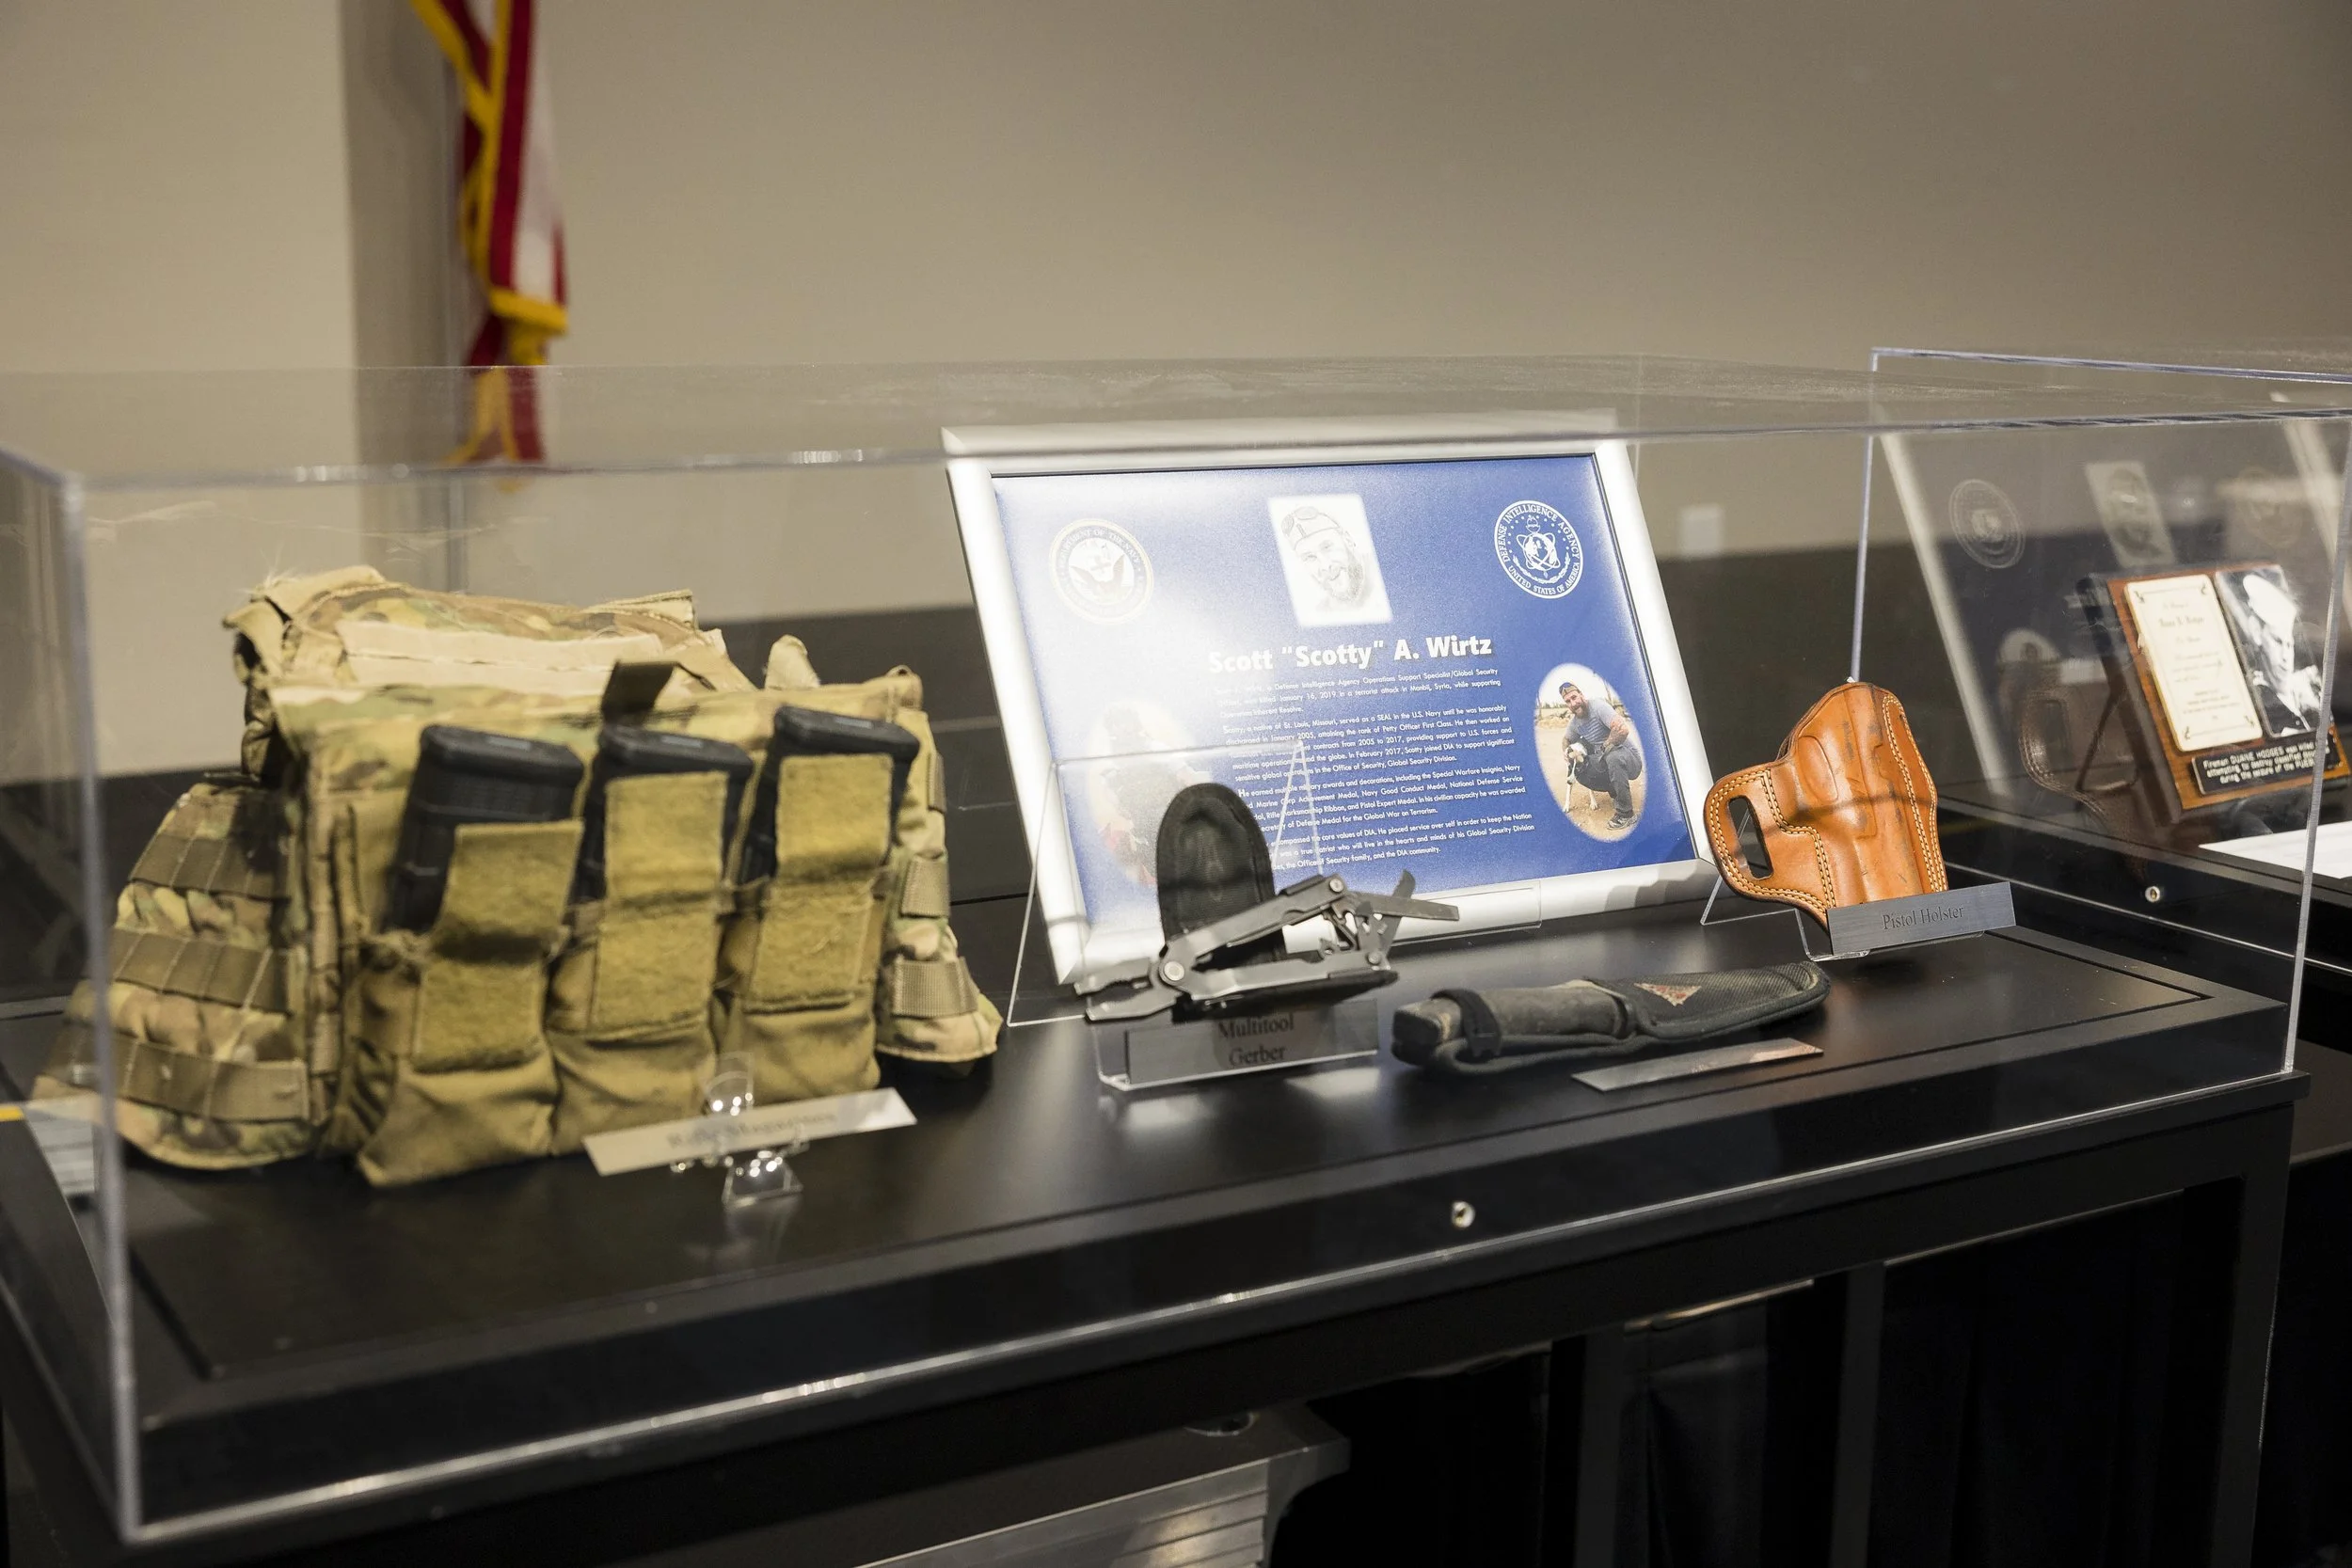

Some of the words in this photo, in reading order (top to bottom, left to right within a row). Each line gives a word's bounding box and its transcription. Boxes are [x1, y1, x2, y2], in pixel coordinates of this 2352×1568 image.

[1502, 504, 1559, 524] INTELLIGENCE
[1498, 524, 1511, 562] DEFENSE
[1557, 521, 1581, 559] AGENCY
[1508, 565, 1532, 589] UNITED
[1534, 585, 1556, 595] STATES
[1556, 584, 1565, 593] OF
[1565, 562, 1581, 589] AMERICA
[1208, 648, 1274, 673] Scott
[1281, 640, 1384, 669] "Scotty"
[1393, 639, 1420, 660] A.
[1425, 635, 1492, 658] Wirtz
[1355, 688, 1378, 696] terrorist
[1434, 683, 1452, 691] Syria,
[1471, 679, 1502, 689] supporting
[1362, 676, 1395, 686] Operations
[1398, 673, 1421, 683] Support
[1422, 670, 1473, 681] Specialist/Global
[1475, 668, 1498, 676] Security
[1340, 716, 1359, 724] served
[1313, 741, 1339, 750] contracts
[1406, 734, 1434, 743] providing
[1436, 731, 1457, 739] support
[1232, 761, 1260, 769] maritime
[1327, 753, 1347, 762] globe.
[1405, 746, 1422, 754] Scotty
[1423, 744, 1442, 753] joined
[1464, 740, 1486, 750] support
[1486, 737, 1515, 748] significant
[1262, 770, 1281, 780] global
[1361, 761, 1386, 769] Security,
[1387, 758, 1408, 767] Global
[1409, 756, 1432, 765] Security
[1251, 787, 1273, 796] earned
[1359, 777, 1394, 785] decorations,
[1395, 773, 1421, 782] including
[1432, 769, 1454, 780] Special
[1481, 766, 1504, 774] Insignia,
[1400, 784, 1424, 793] Conduct
[1450, 780, 1474, 788] National
[1376, 799, 1397, 808] Expert
[1454, 791, 1479, 800] capacity
[1500, 785, 1526, 795] awarded
[1322, 816, 1342, 825] Medal
[1363, 812, 1385, 820] Global
[1409, 807, 1438, 816] Terrorism.
[1315, 845, 1335, 853] atriot
[1395, 836, 1414, 845] hearts
[1466, 829, 1487, 837] Global
[1488, 826, 1512, 834] Security
[1388, 825, 1408, 835] placed
[1326, 856, 1349, 864] Security
[1408, 847, 1441, 855] community.
[1882, 911, 1916, 930] Pistol
[1920, 906, 1965, 925] Holster
[1217, 1012, 1294, 1038] Multitool
[1228, 1043, 1286, 1067] Gerber
